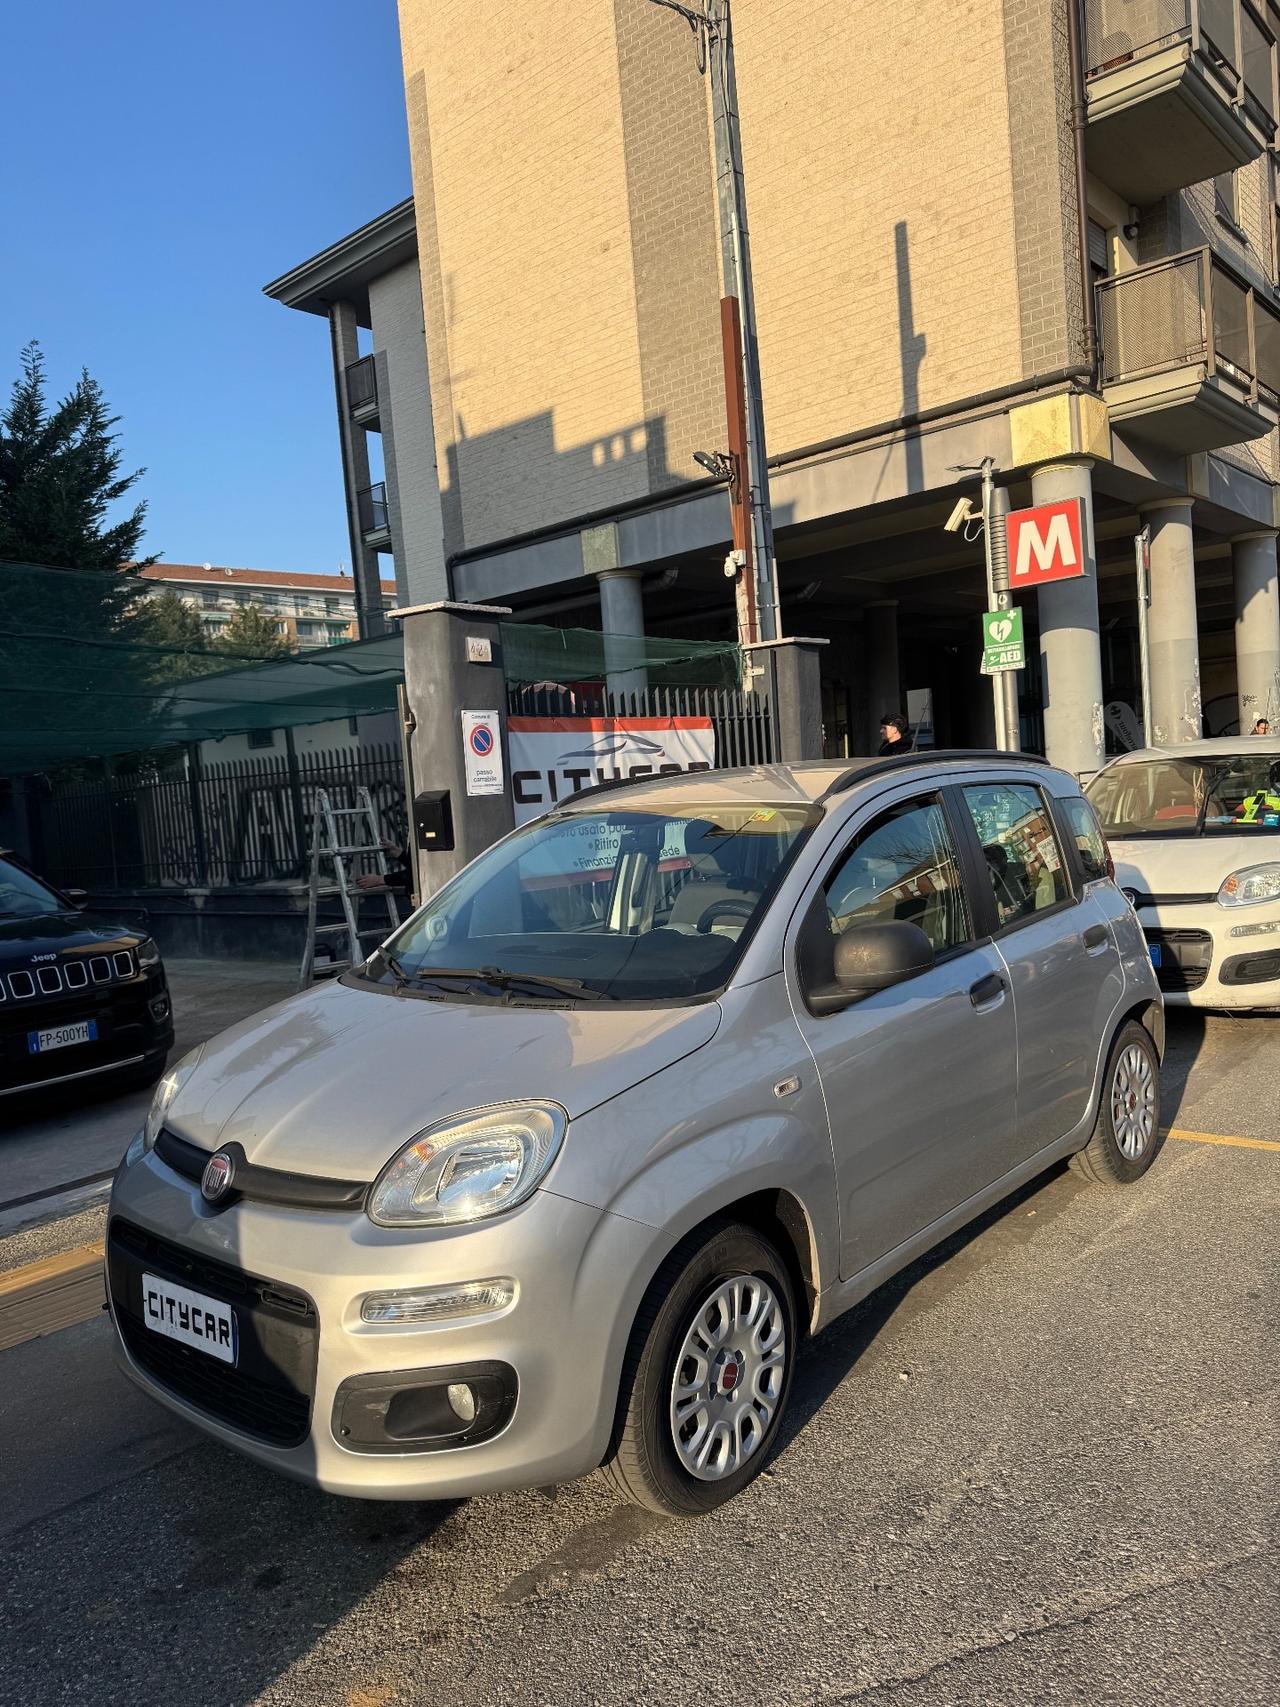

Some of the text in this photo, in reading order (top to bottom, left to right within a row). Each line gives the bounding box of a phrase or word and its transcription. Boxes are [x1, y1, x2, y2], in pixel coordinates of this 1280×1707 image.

[1015, 513, 1077, 576] M
[1000, 650, 1021, 664] AED
[476, 769, 493, 777] passo
[473, 776, 497, 784] carrabile
[30, 952, 57, 963] Jeep
[147, 1290, 232, 1347] CITYCAR
